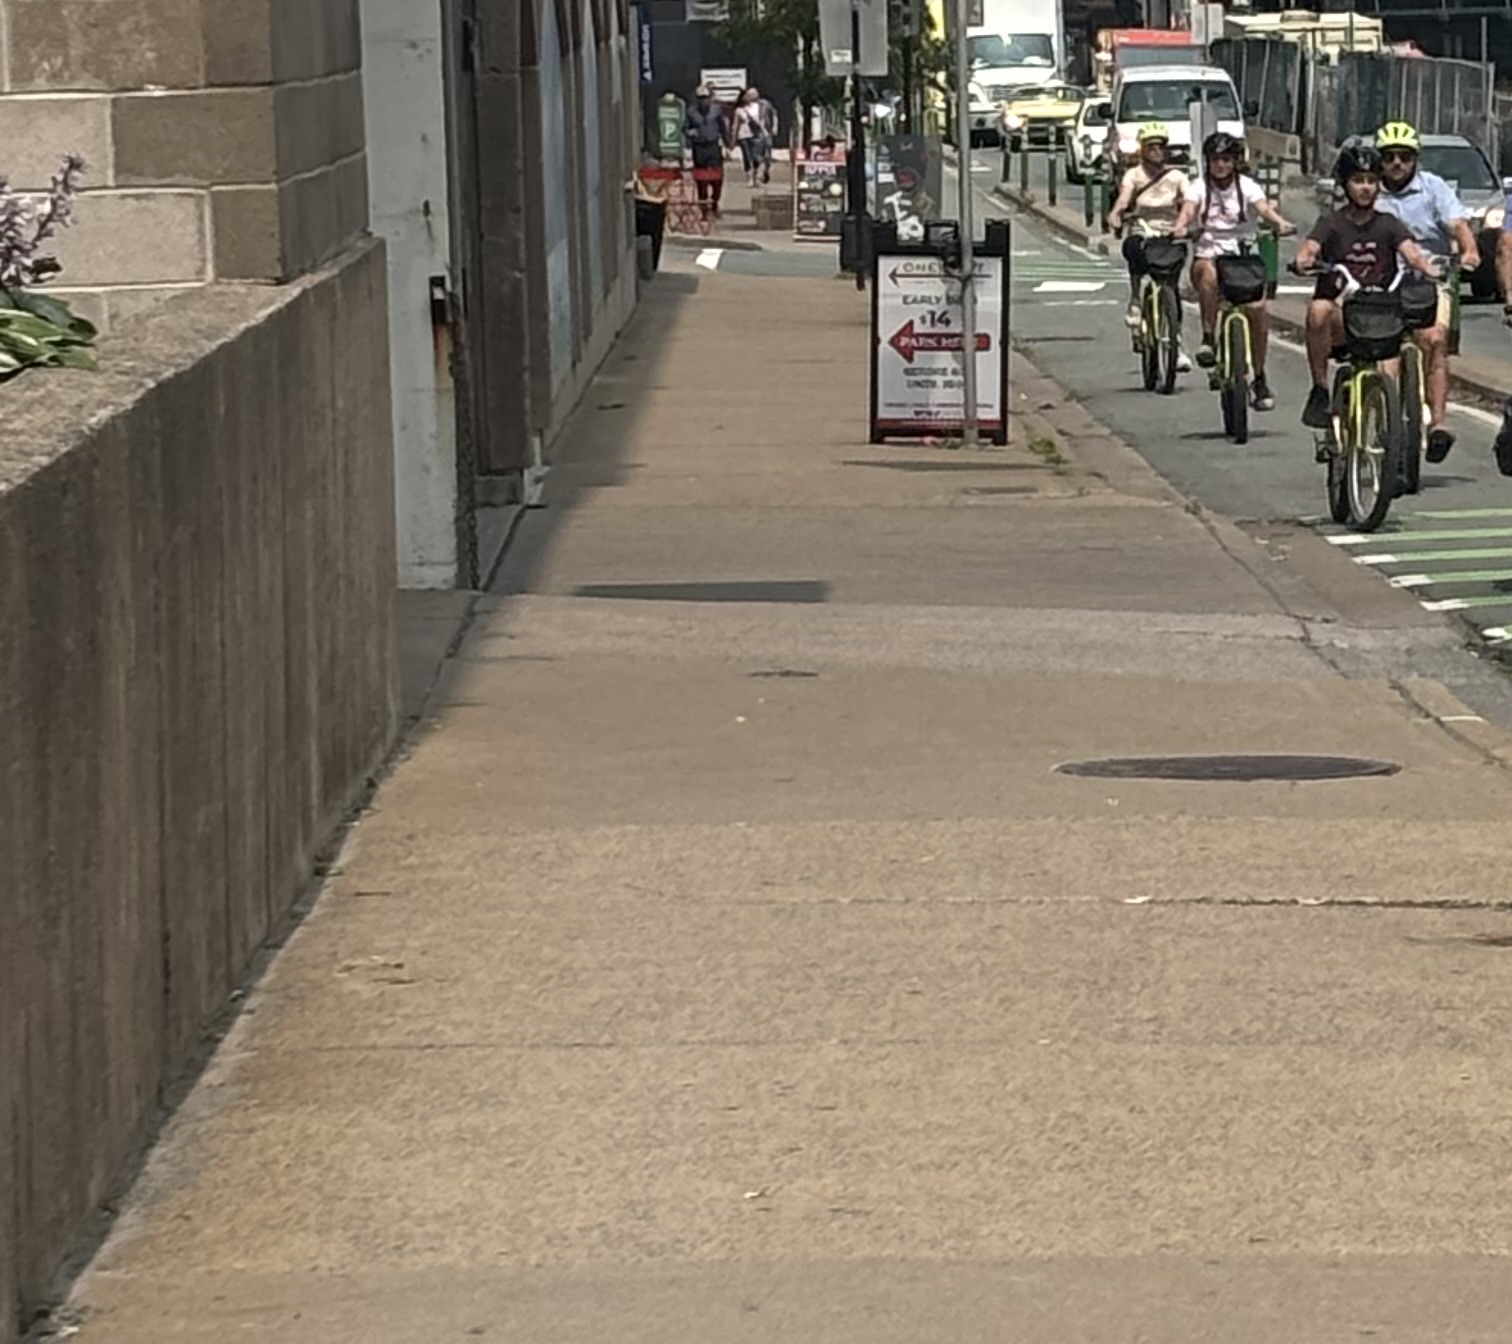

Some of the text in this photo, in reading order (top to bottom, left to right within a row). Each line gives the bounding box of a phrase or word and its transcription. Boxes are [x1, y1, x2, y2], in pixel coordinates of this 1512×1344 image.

[902, 294, 942, 306] EARLY
[919, 310, 951, 328] $14
[900, 335, 938, 348] PARK
